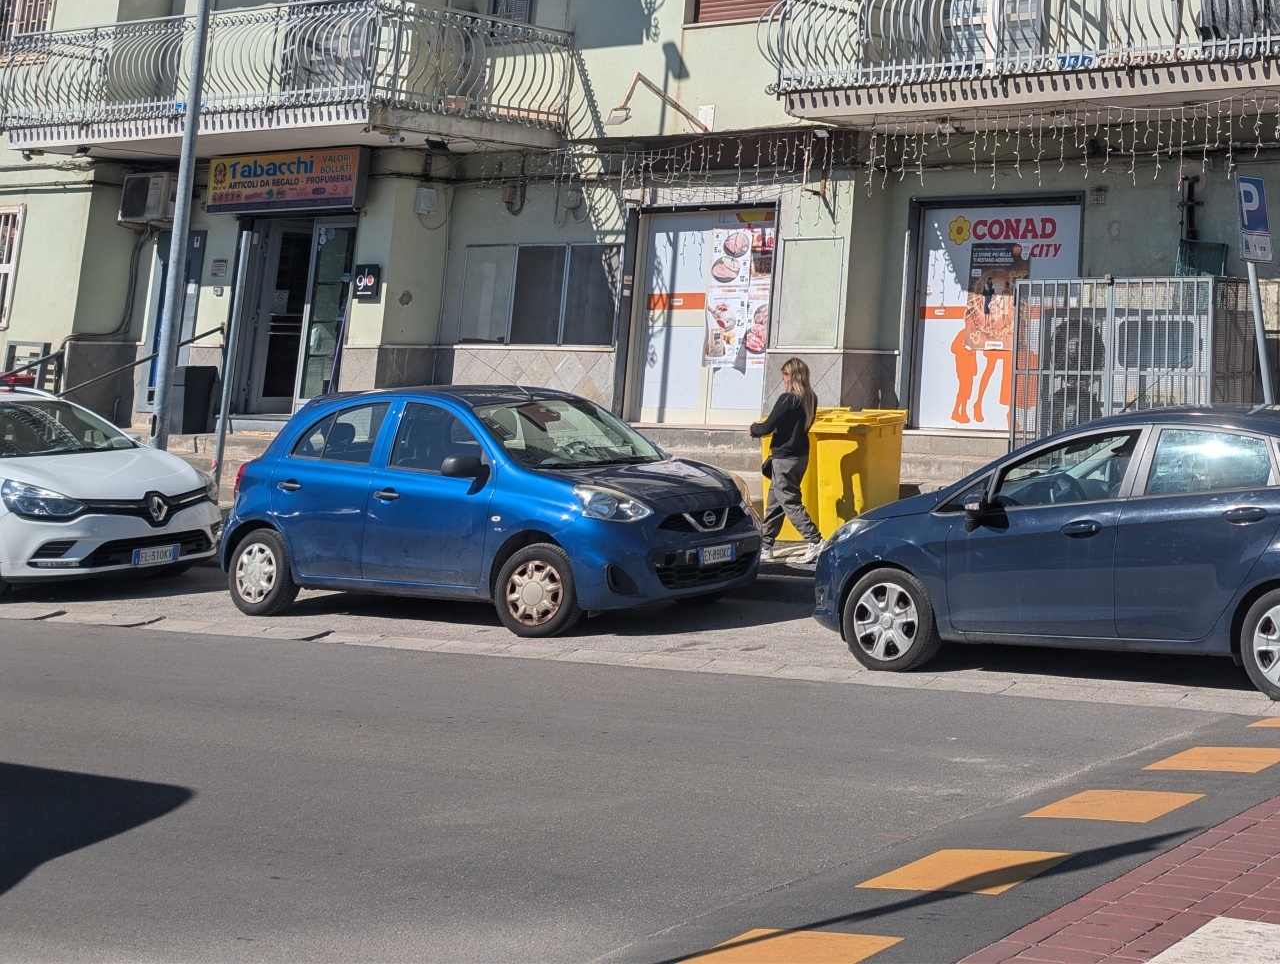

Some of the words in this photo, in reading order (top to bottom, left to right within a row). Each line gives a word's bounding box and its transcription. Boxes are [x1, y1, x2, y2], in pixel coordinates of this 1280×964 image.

[228, 154, 314, 179] Tabacchi
[322, 154, 352, 162] VALORI
[320, 164, 352, 174] BOLLATI
[228, 180, 258, 190] ARTICOLI
[260, 179, 270, 188] DA
[272, 178, 300, 186] REGALO
[306, 174, 352, 184] PROFUMERIA
[1240, 182, 1259, 226] P
[972, 218, 1057, 240] CONAD
[1031, 244, 1062, 258] CITY
[356, 268, 374, 290] glo
